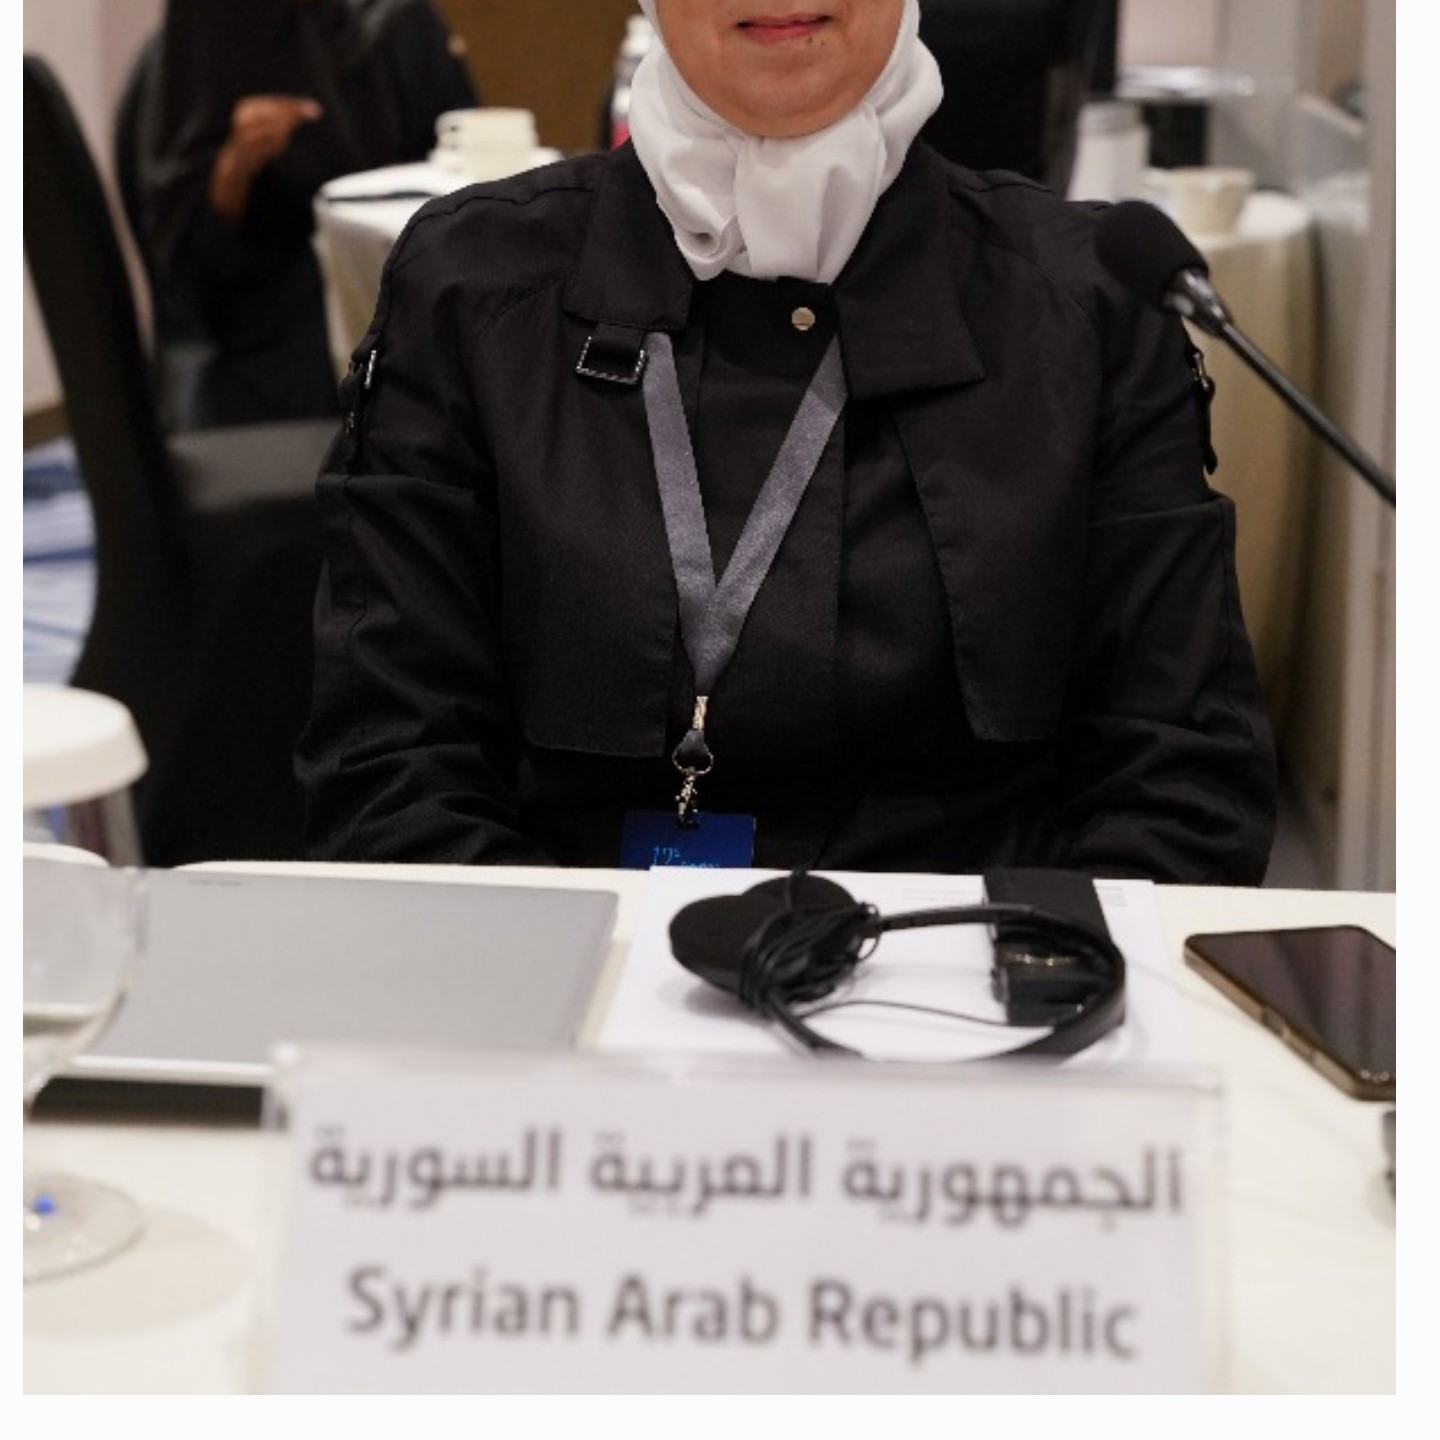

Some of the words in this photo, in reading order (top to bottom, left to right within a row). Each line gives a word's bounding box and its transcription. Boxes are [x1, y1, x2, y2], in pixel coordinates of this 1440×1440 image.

[309, 1125, 561, 1210] السورية
[588, 1131, 813, 1220] العربية
[844, 1137, 1186, 1230] الجمهورية
[345, 1264, 580, 1349] Syrian
[606, 1272, 780, 1345] Arab
[808, 1278, 1141, 1367] Republic
